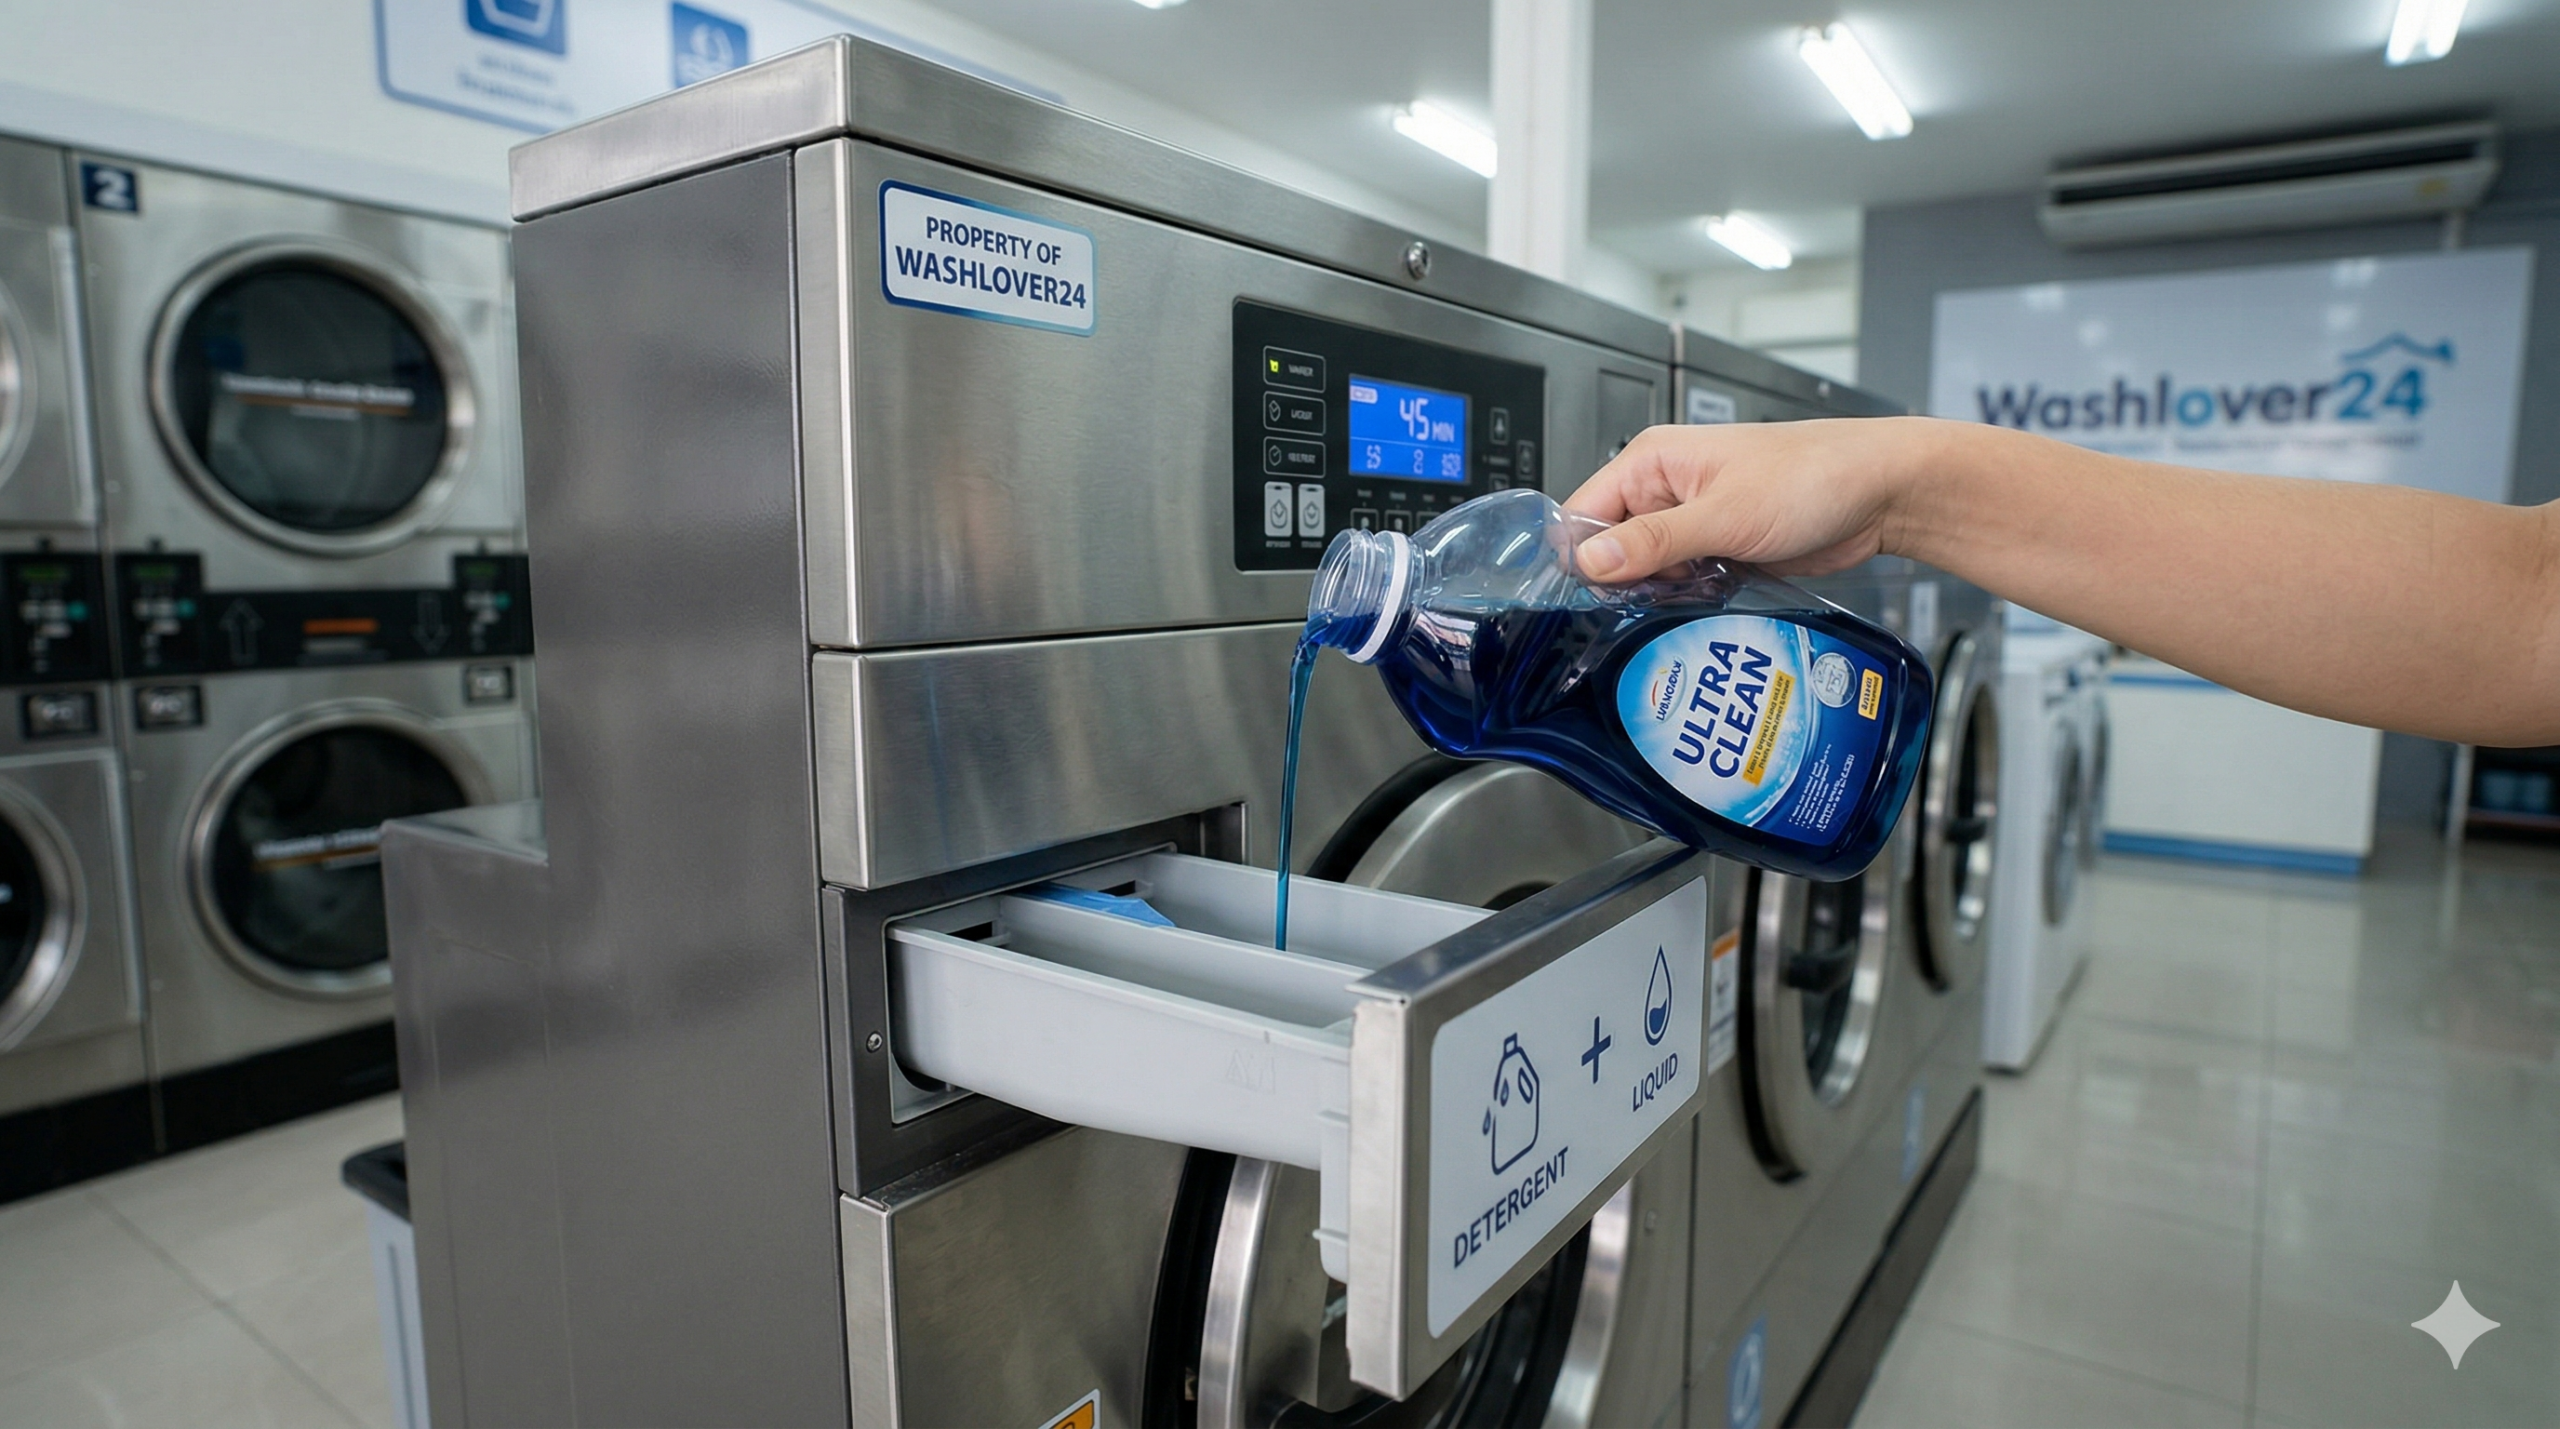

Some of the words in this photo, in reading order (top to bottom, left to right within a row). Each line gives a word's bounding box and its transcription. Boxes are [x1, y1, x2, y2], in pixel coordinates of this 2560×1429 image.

[93, 169, 132, 209] 2
[926, 216, 1032, 260] PROPERTY
[1037, 242, 1061, 265] OF
[895, 245, 1087, 309] WASHLOVER24
[1399, 398, 1430, 441] 45
[1432, 420, 1455, 443] MIN
[1974, 366, 2427, 431] Washlover24
[1672, 641, 1740, 765] ULTRA
[1709, 645, 1772, 778] CLEAN
[1632, 1052, 1679, 1112] LIQUID
[1453, 1145, 1569, 1269] DETERGENT
